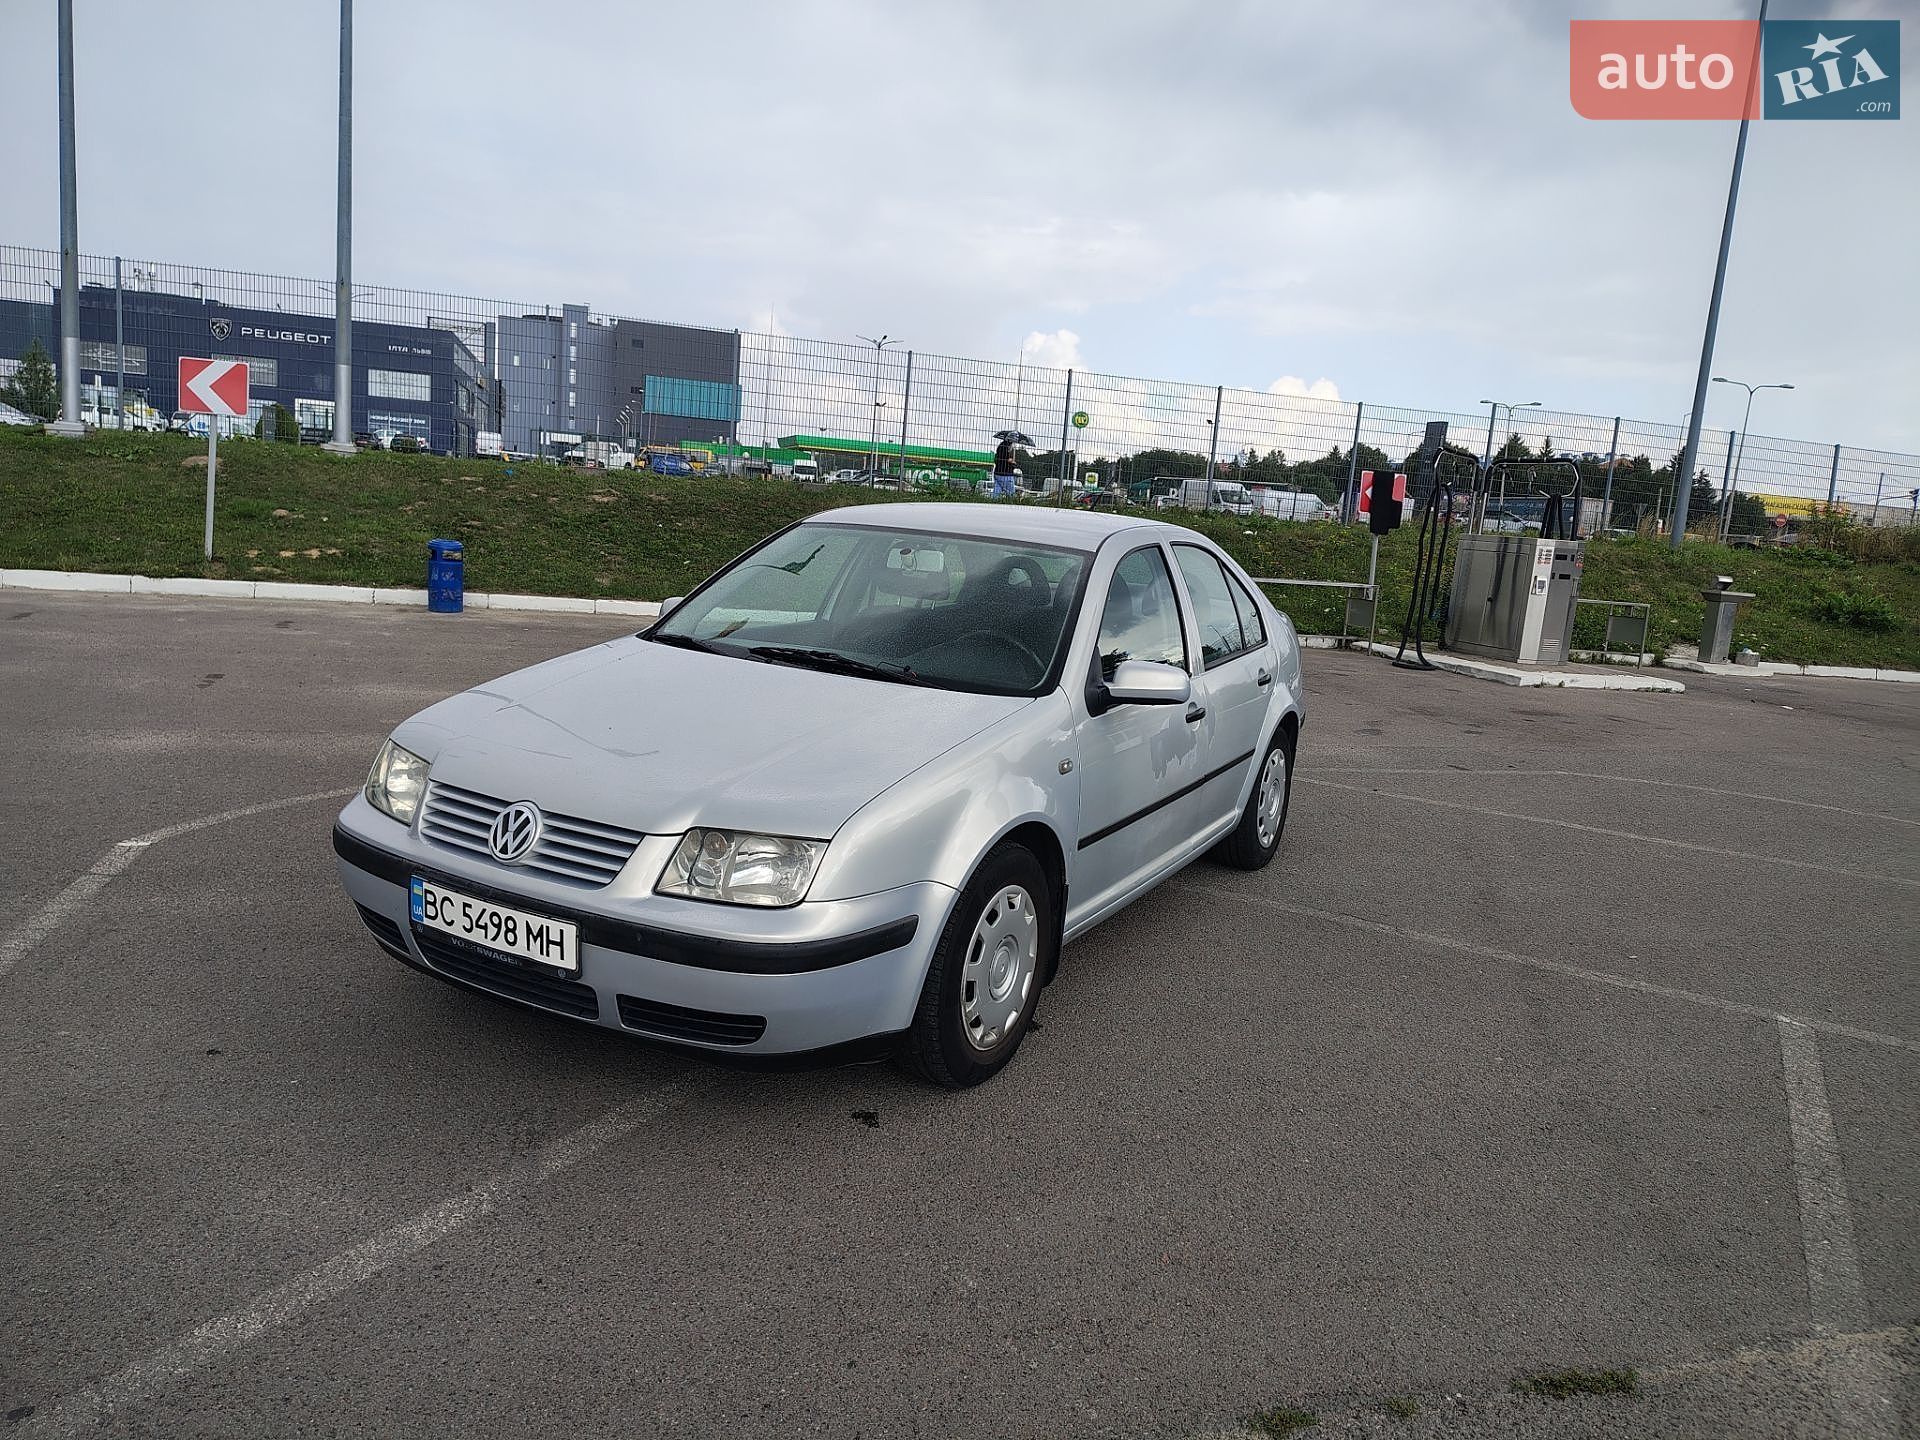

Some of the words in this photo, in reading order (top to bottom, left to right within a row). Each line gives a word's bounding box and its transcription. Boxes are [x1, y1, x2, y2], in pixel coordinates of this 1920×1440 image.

[241, 326, 332, 345] PEUGEOT
[413, 904, 424, 916] UA
[424, 888, 455, 927] BC
[462, 901, 518, 947] 5498
[525, 919, 565, 961] MH
